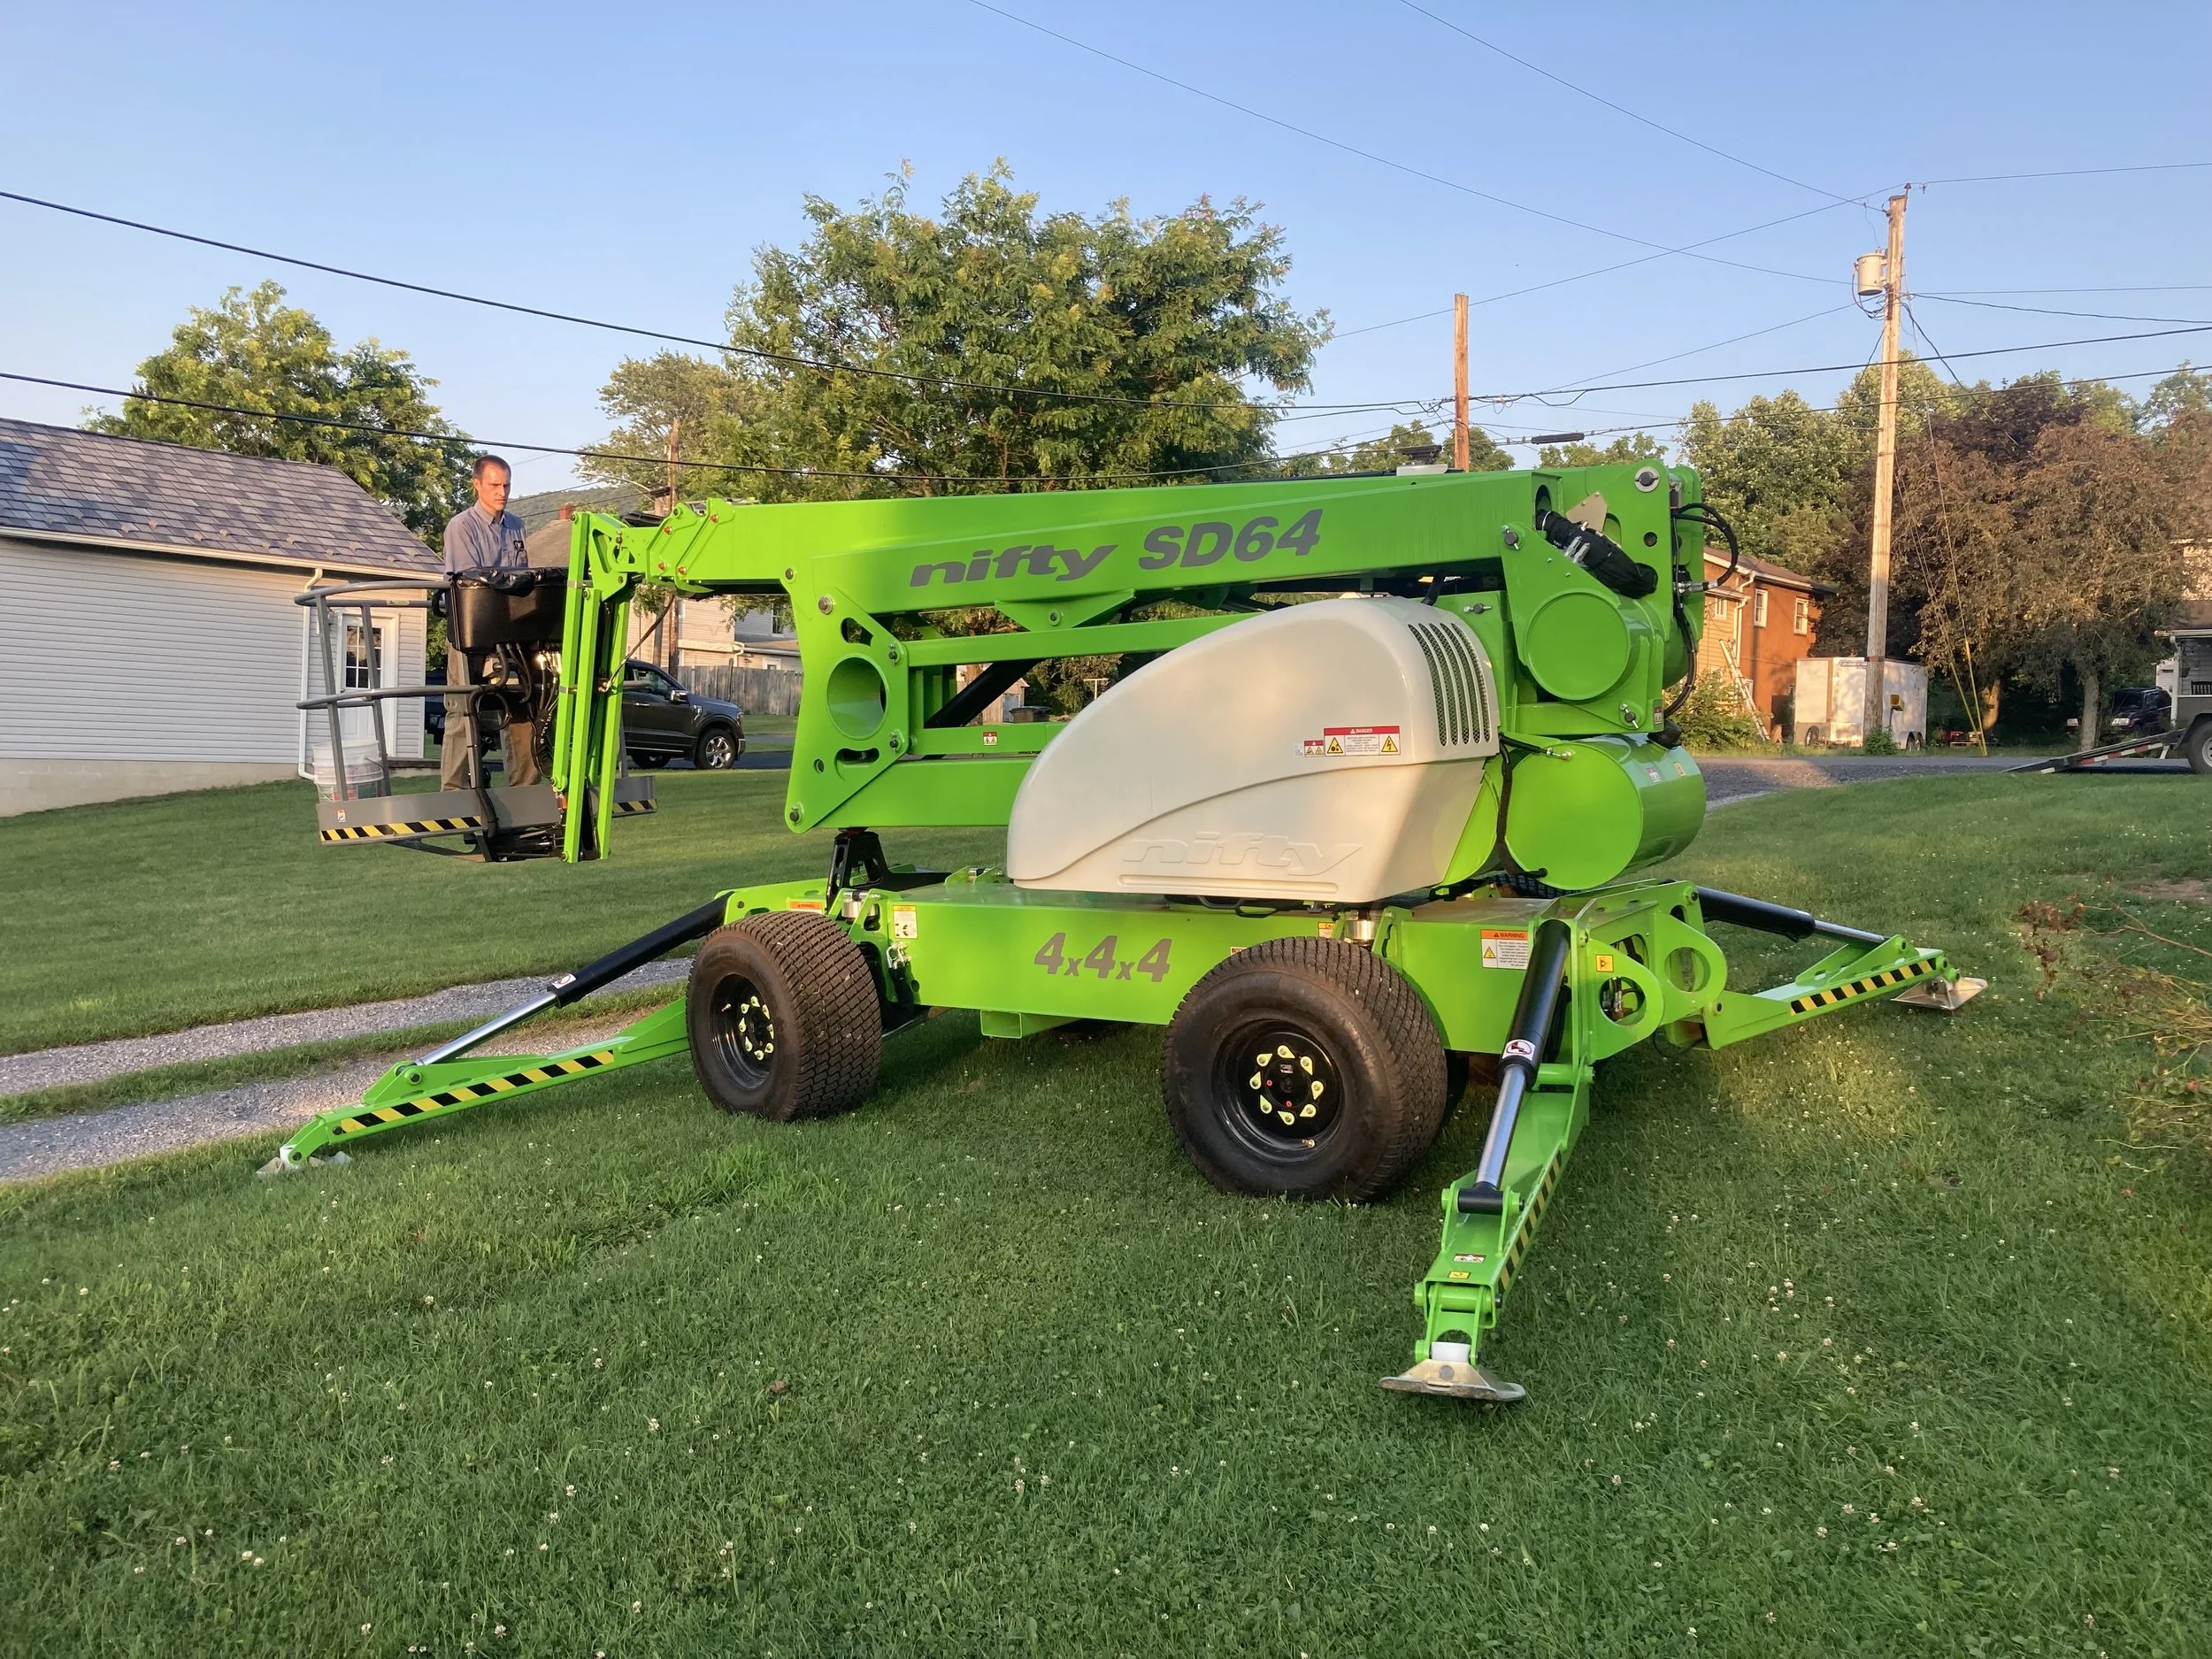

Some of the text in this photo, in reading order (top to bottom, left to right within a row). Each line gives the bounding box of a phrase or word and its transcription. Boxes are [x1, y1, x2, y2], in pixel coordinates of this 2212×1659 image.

[910, 509, 1324, 587] nifty SD64
[1122, 832, 1363, 876] nifty
